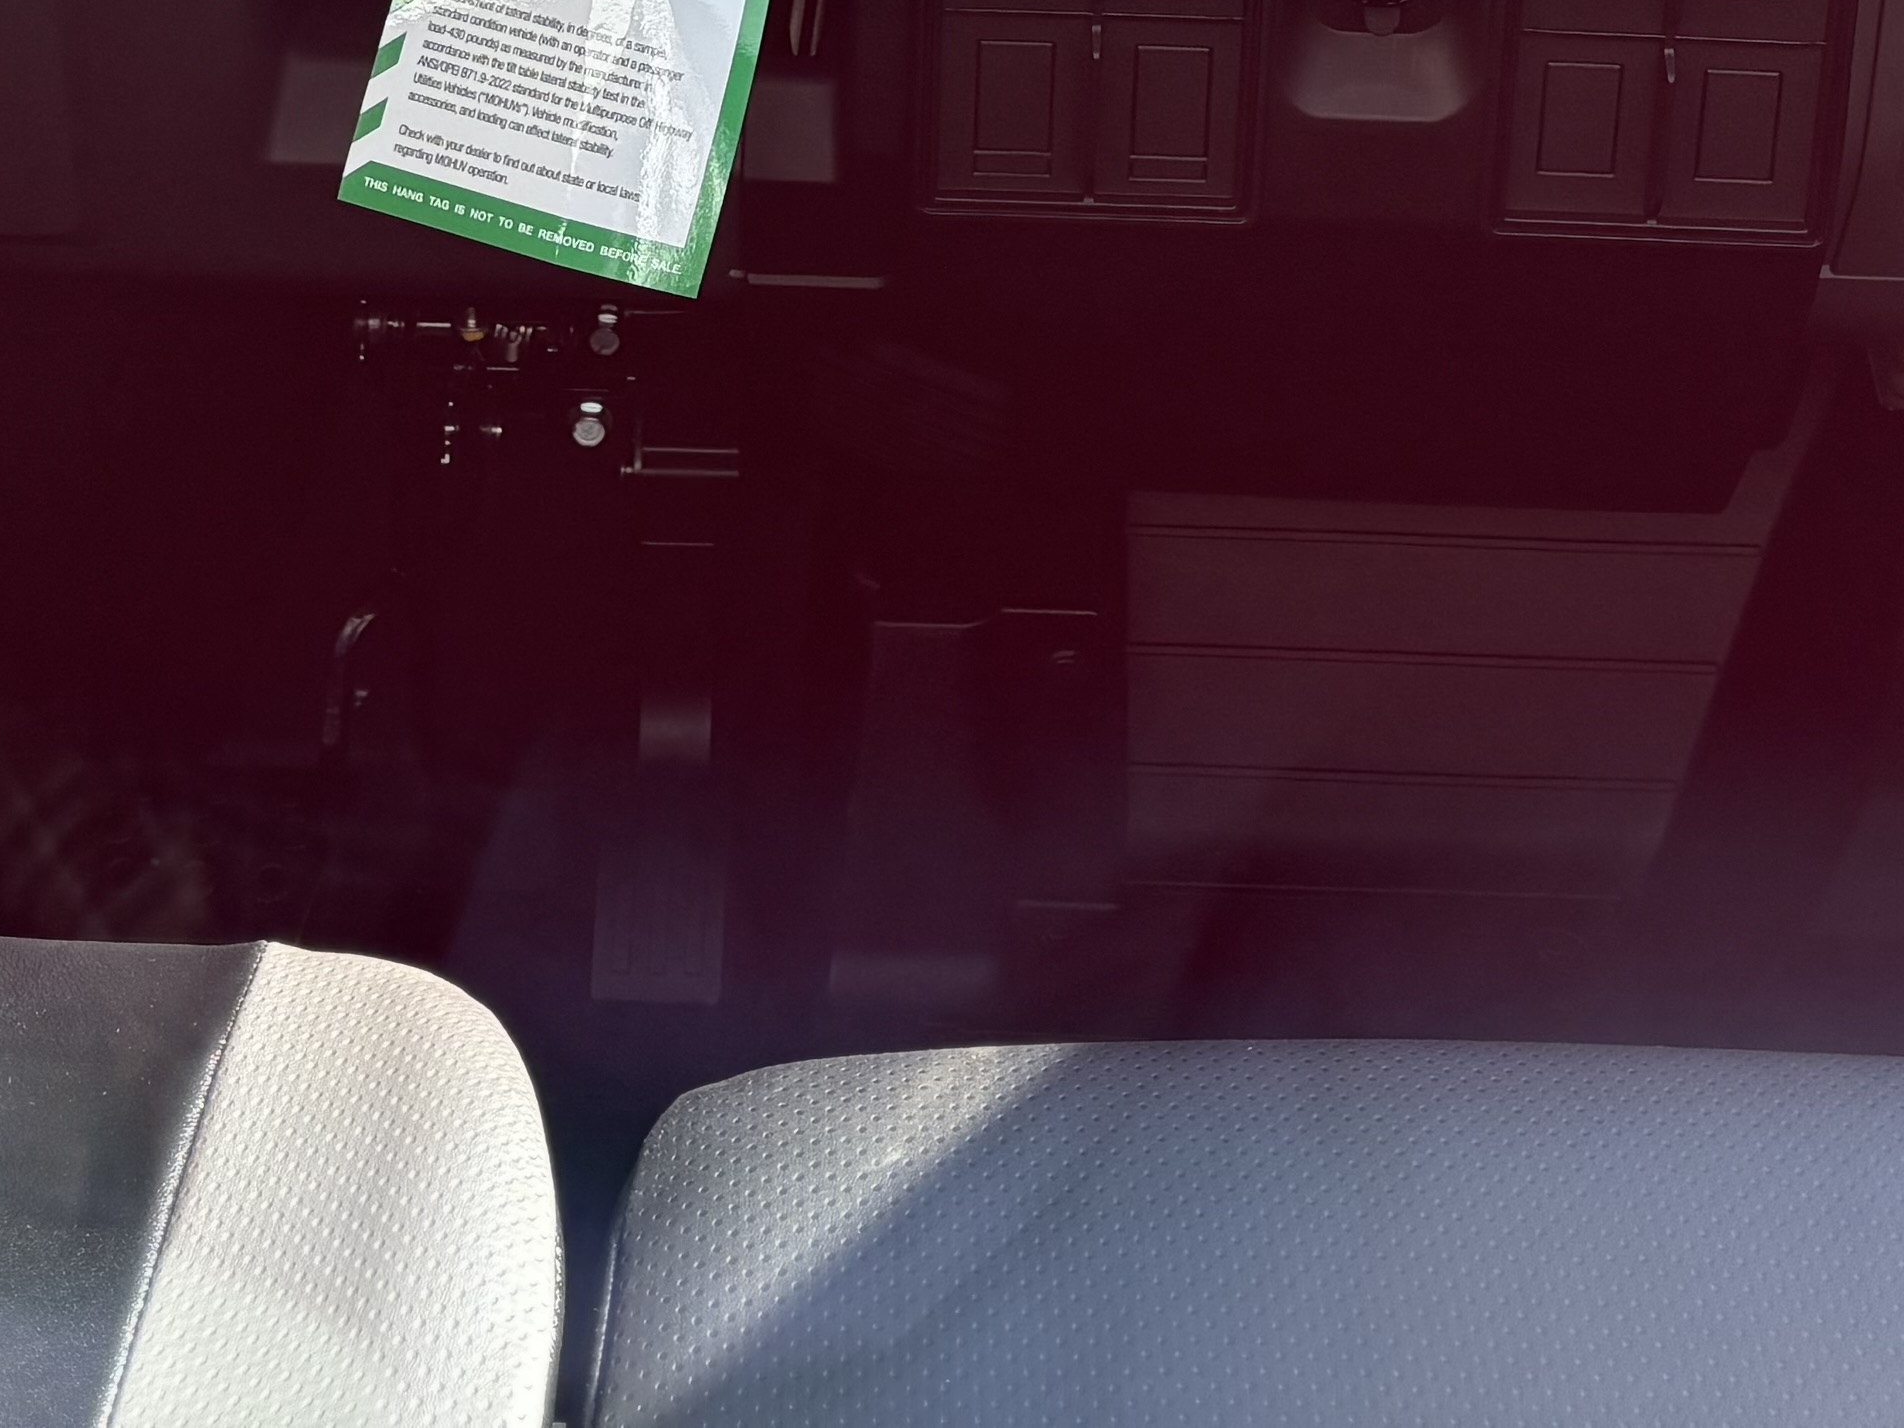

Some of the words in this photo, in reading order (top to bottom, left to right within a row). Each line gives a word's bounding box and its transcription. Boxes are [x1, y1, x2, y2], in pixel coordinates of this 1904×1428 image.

[364, 176, 388, 192] THIS
[392, 184, 423, 202] HANG
[429, 195, 449, 210] TAG
[454, 203, 465, 215] IS
[469, 208, 494, 222] NOT
[498, 215, 513, 229] TO
[517, 222, 533, 235] BE
[537, 228, 595, 253] REMOVED
[599, 244, 648, 267] BEFORE
